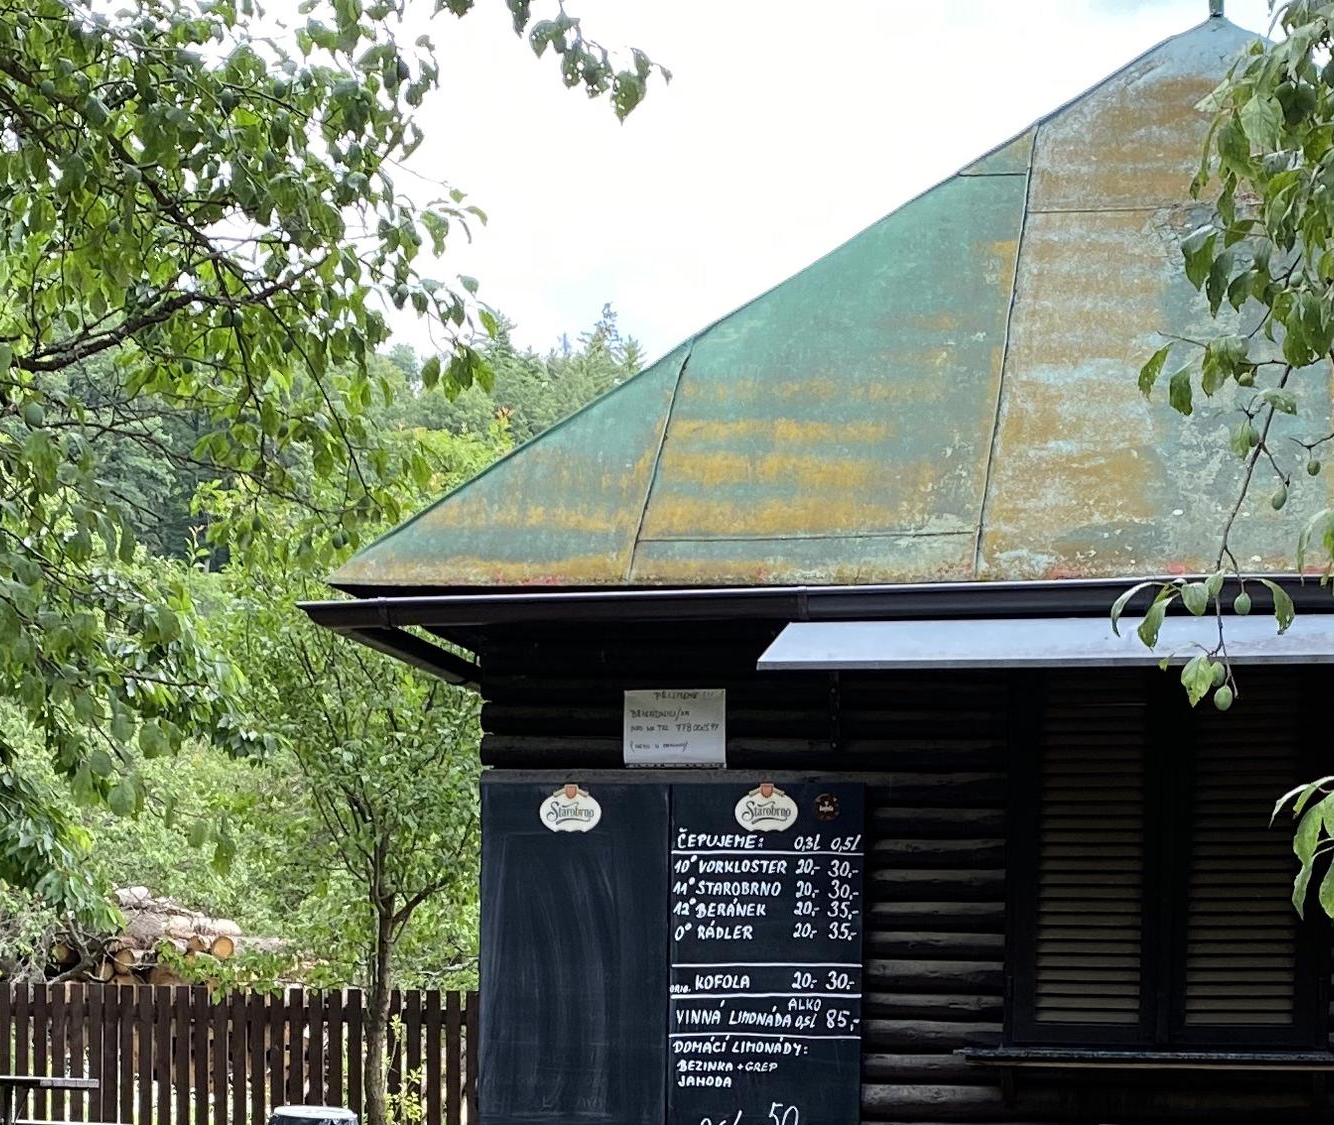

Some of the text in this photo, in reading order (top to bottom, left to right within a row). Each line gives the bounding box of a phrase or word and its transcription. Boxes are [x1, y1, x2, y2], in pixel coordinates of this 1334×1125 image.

[547, 801, 594, 825] Starobrno
[742, 800, 791, 825] Starobrno
[677, 827, 765, 849] ČEPUJEME:
[698, 859, 788, 875] VORKLOSTER
[695, 879, 782, 897] STAROBRNO
[696, 898, 767, 919] BERÁNEK
[697, 920, 754, 940] RÁDLER
[695, 974, 751, 991] KOFOLA
[788, 998, 821, 1011] ALKO
[676, 1000, 725, 1025] VINNÁ
[728, 1006, 791, 1028] LIMONÁDA
[826, 1009, 860, 1032] 85,-
[673, 1034, 730, 1054] DOMÁCÍ
[677, 1059, 734, 1072] BEZINKA
[677, 1075, 732, 1088] JAHODA
